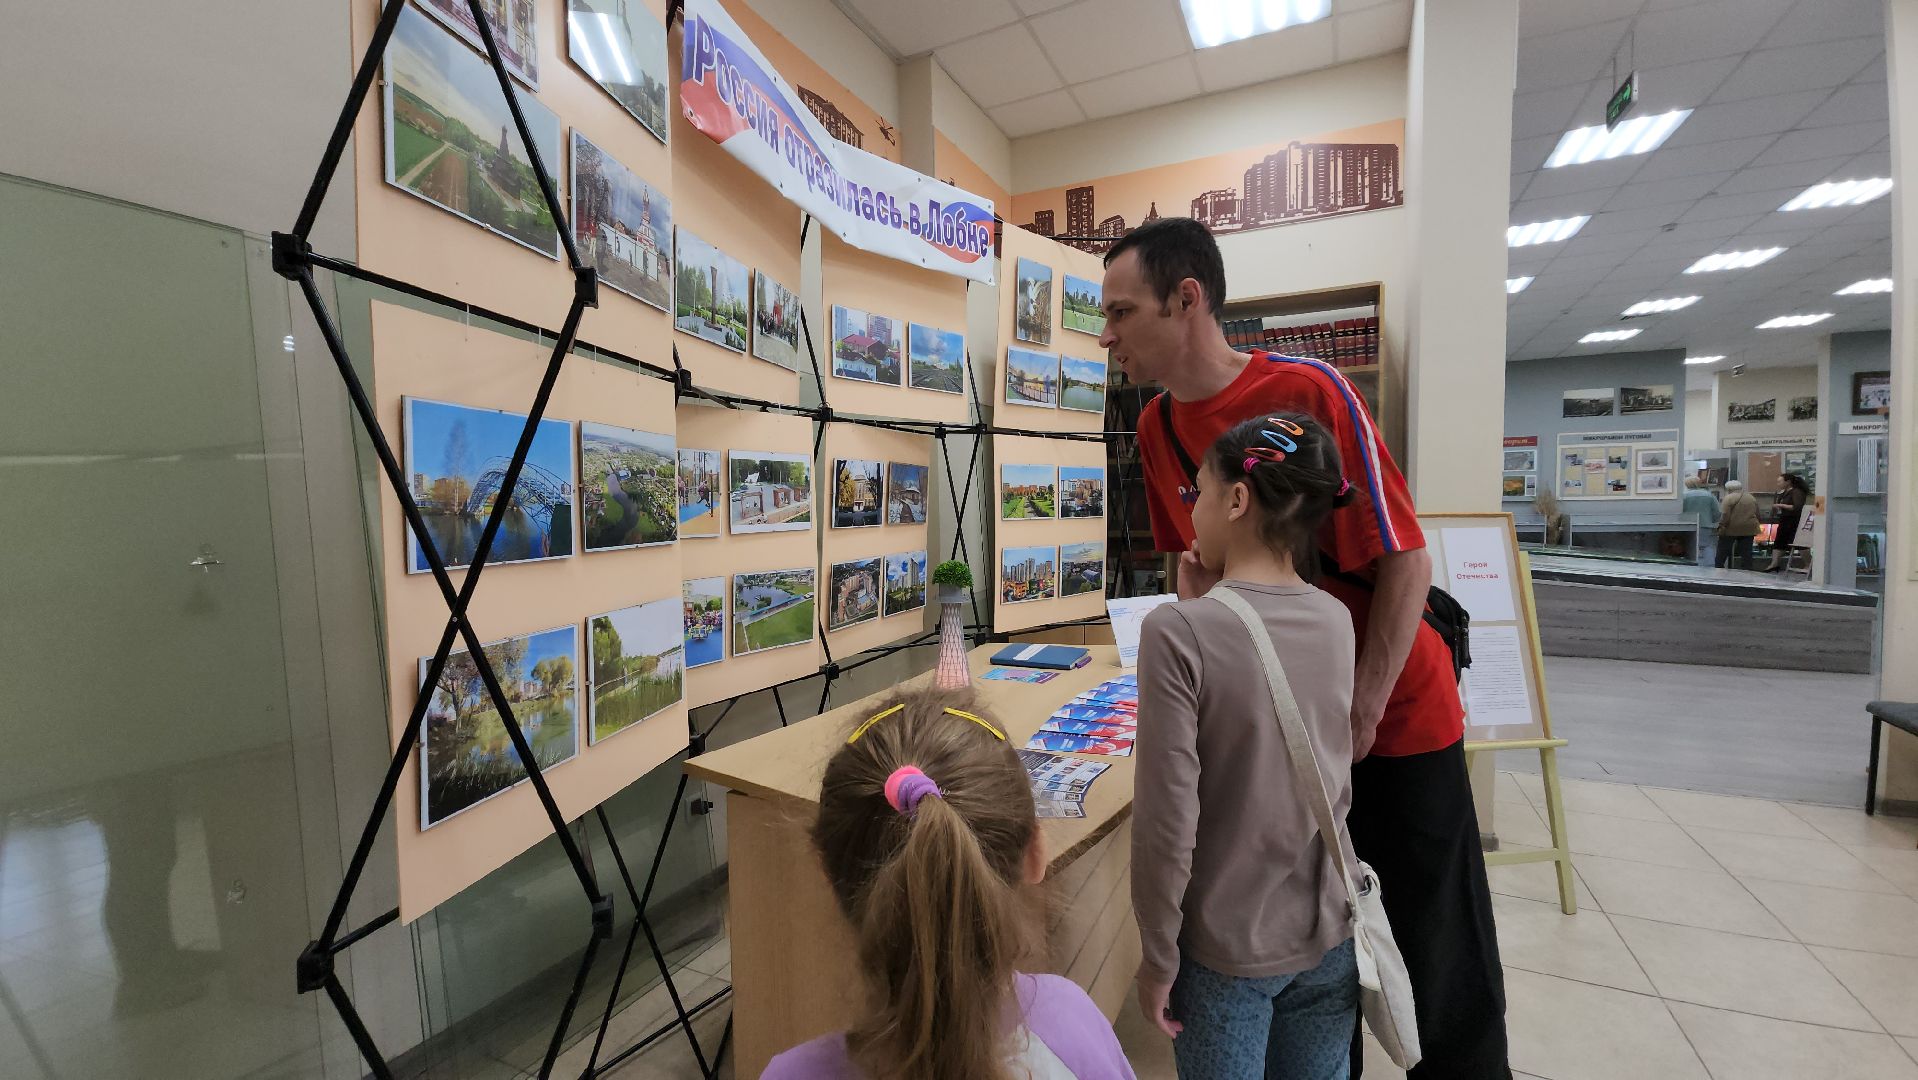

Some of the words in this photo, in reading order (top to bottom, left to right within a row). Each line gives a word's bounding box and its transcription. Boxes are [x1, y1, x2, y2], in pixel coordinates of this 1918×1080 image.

[693, 12, 780, 155] Россия
[784, 123, 903, 230] отразилась
[909, 201, 923, 237] в
[925, 199, 990, 258] Лобне
